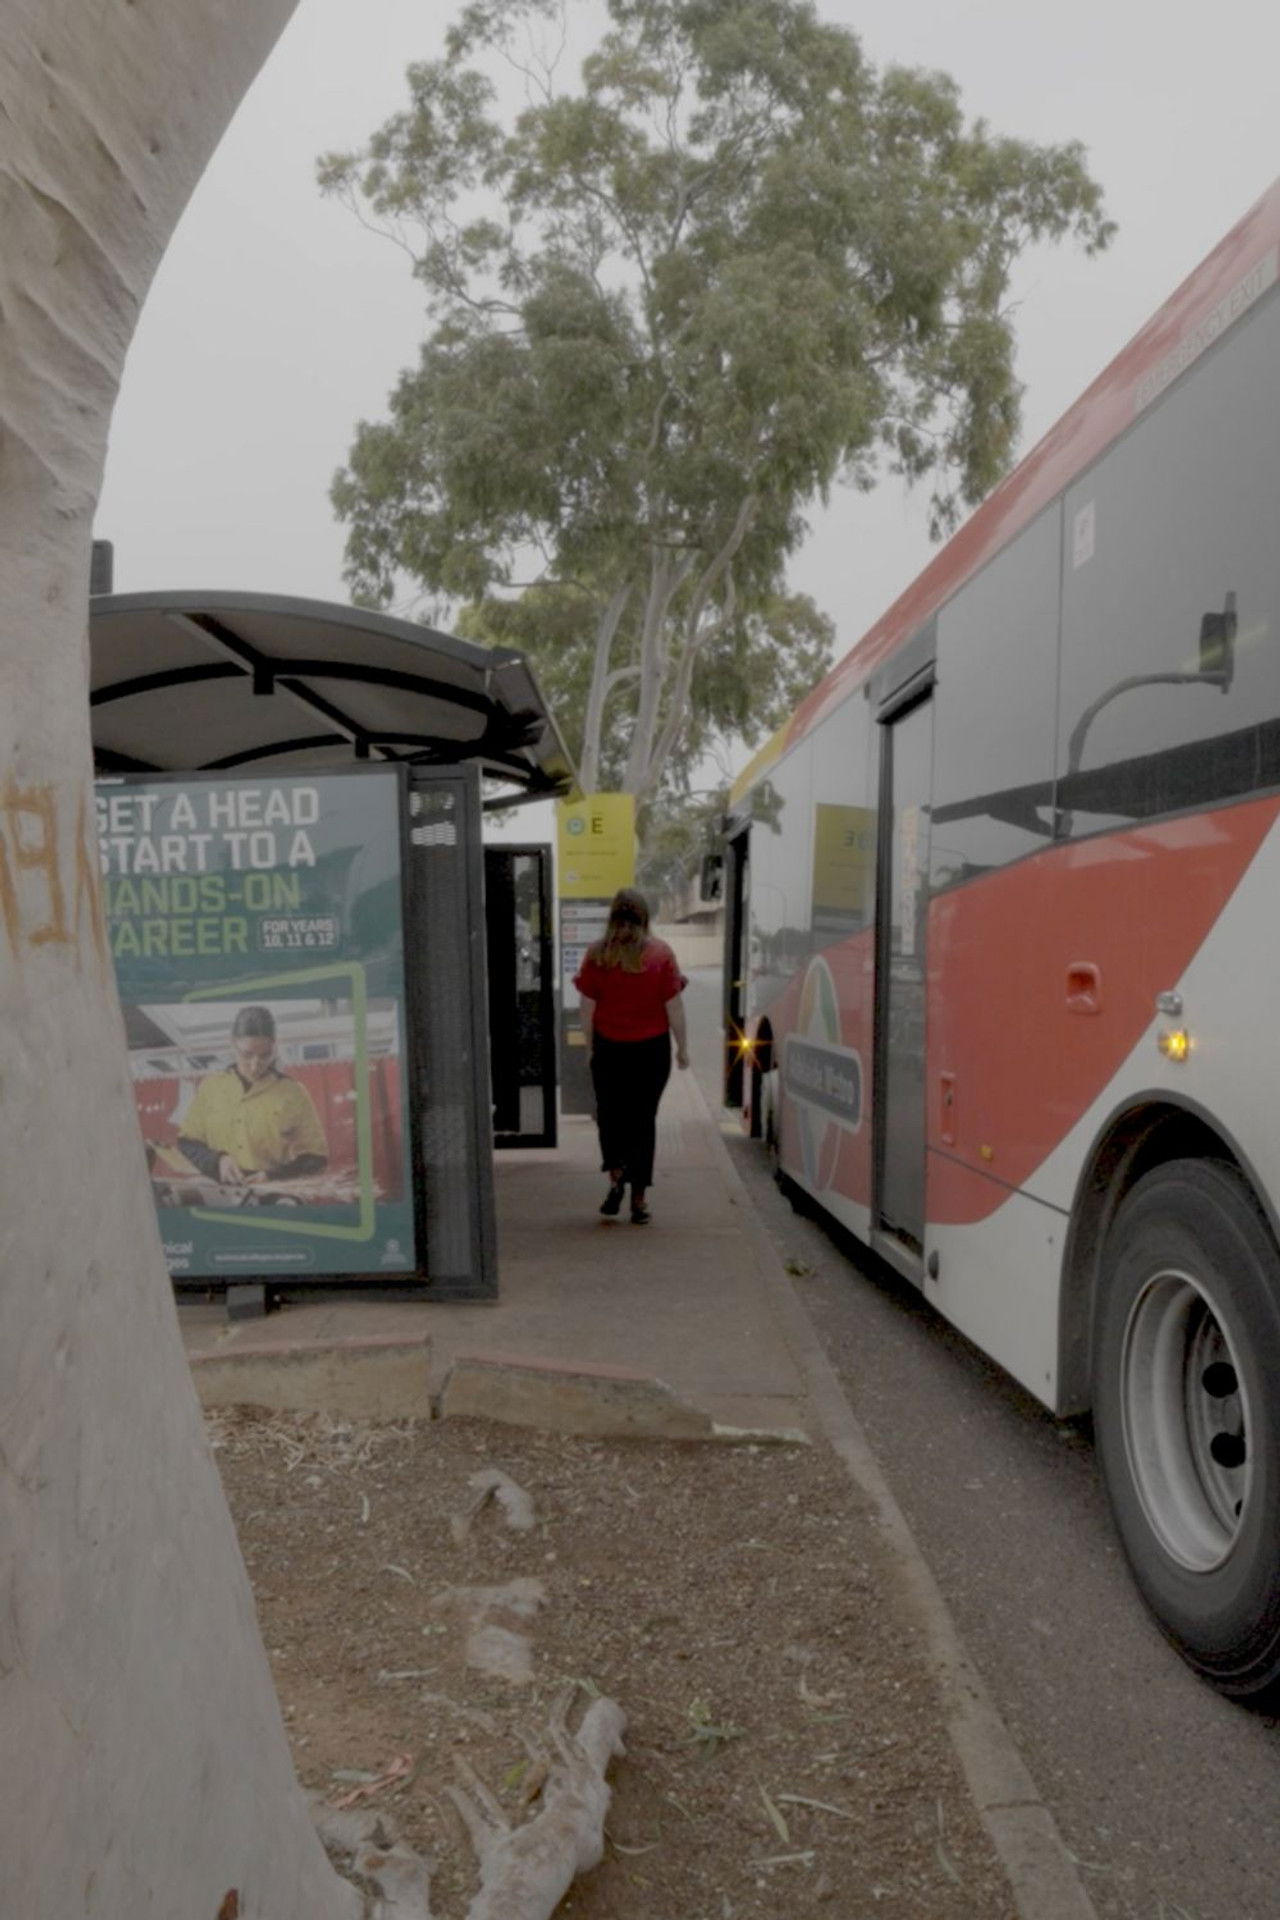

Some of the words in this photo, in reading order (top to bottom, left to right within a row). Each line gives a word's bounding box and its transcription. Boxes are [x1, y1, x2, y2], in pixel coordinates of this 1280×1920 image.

[169, 792, 198, 831] A
[209, 787, 320, 829] HEAD
[591, 817, 604, 834] E
[222, 831, 277, 870] TO
[287, 828, 316, 868] A
[110, 916, 250, 957] AREER
[262, 919, 289, 933] FOR
[291, 918, 334, 932] YEARS
[318, 932, 335, 946] 12
